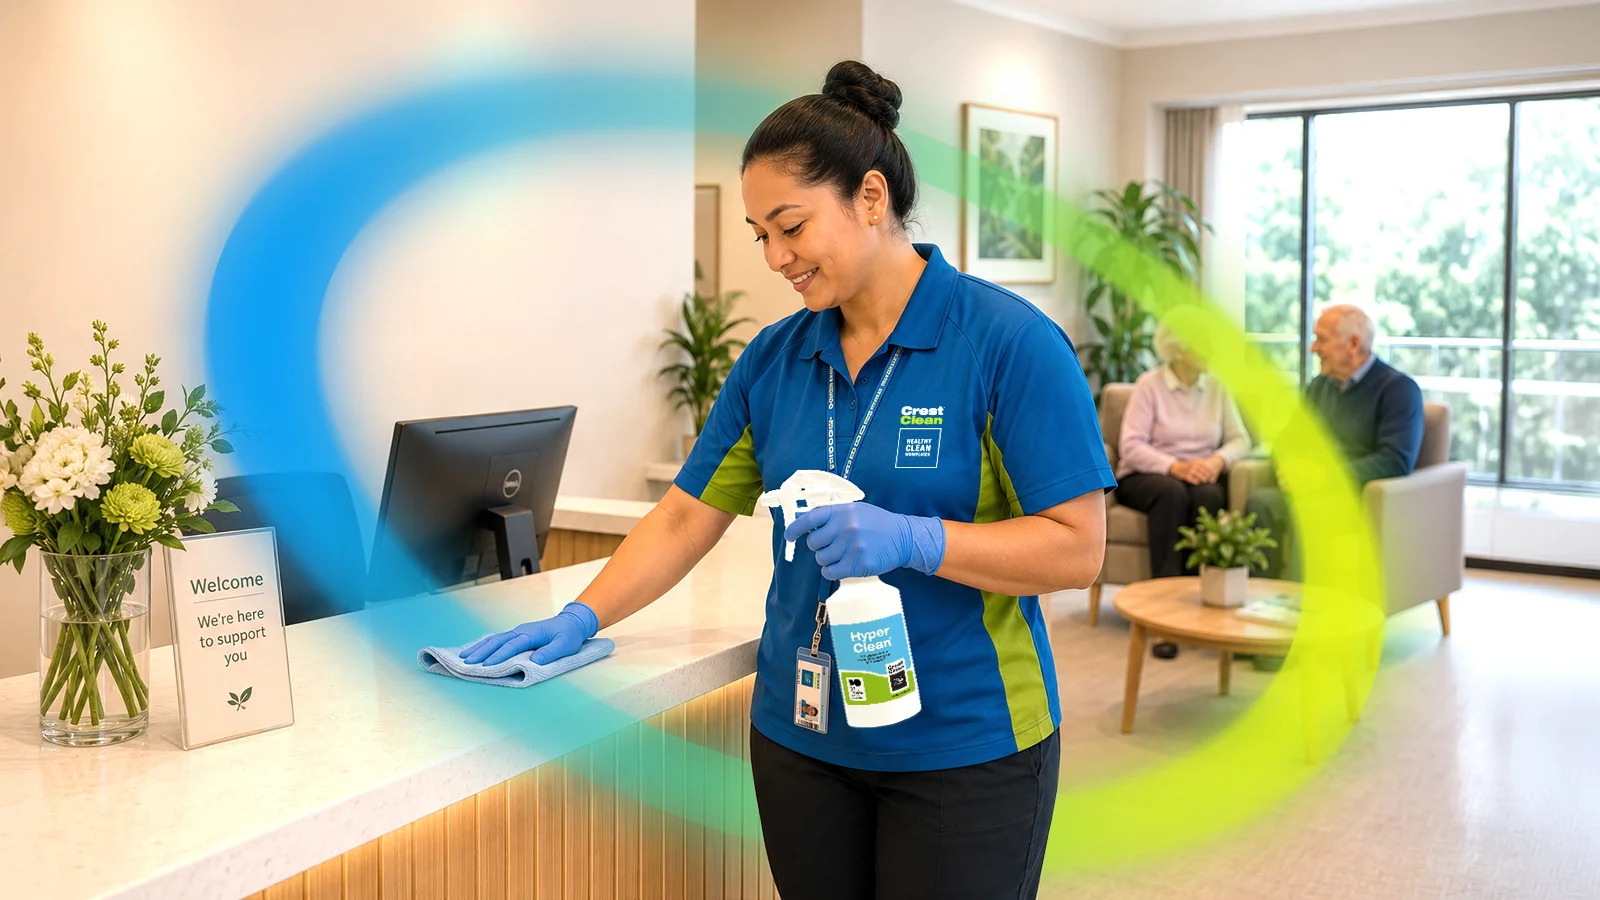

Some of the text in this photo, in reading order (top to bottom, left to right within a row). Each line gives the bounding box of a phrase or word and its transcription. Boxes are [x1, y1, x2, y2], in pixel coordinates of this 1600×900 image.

[901, 406, 944, 416] Crest
[900, 415, 943, 425] Clean
[905, 444, 932, 452] CLEAN
[190, 574, 264, 595] Welcome
[197, 609, 264, 629] We're here
[199, 626, 266, 648] to support
[850, 627, 890, 642] Hyper
[853, 639, 892, 653] Clean
[224, 651, 248, 667] you
